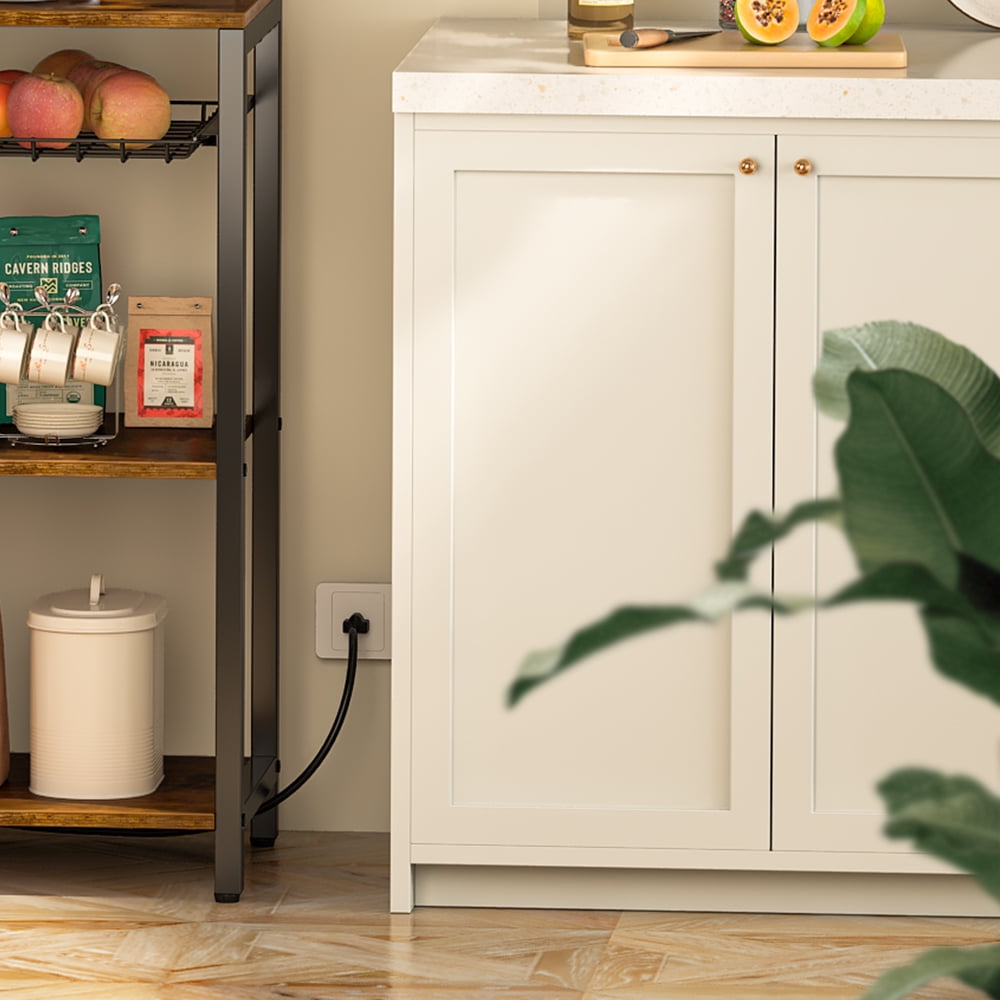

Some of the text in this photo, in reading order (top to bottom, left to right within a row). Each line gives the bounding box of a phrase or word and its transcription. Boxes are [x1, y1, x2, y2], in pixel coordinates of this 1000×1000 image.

[4, 261, 93, 275] CAVERN RIDGES
[150, 360, 189, 368] NICARAGUA
